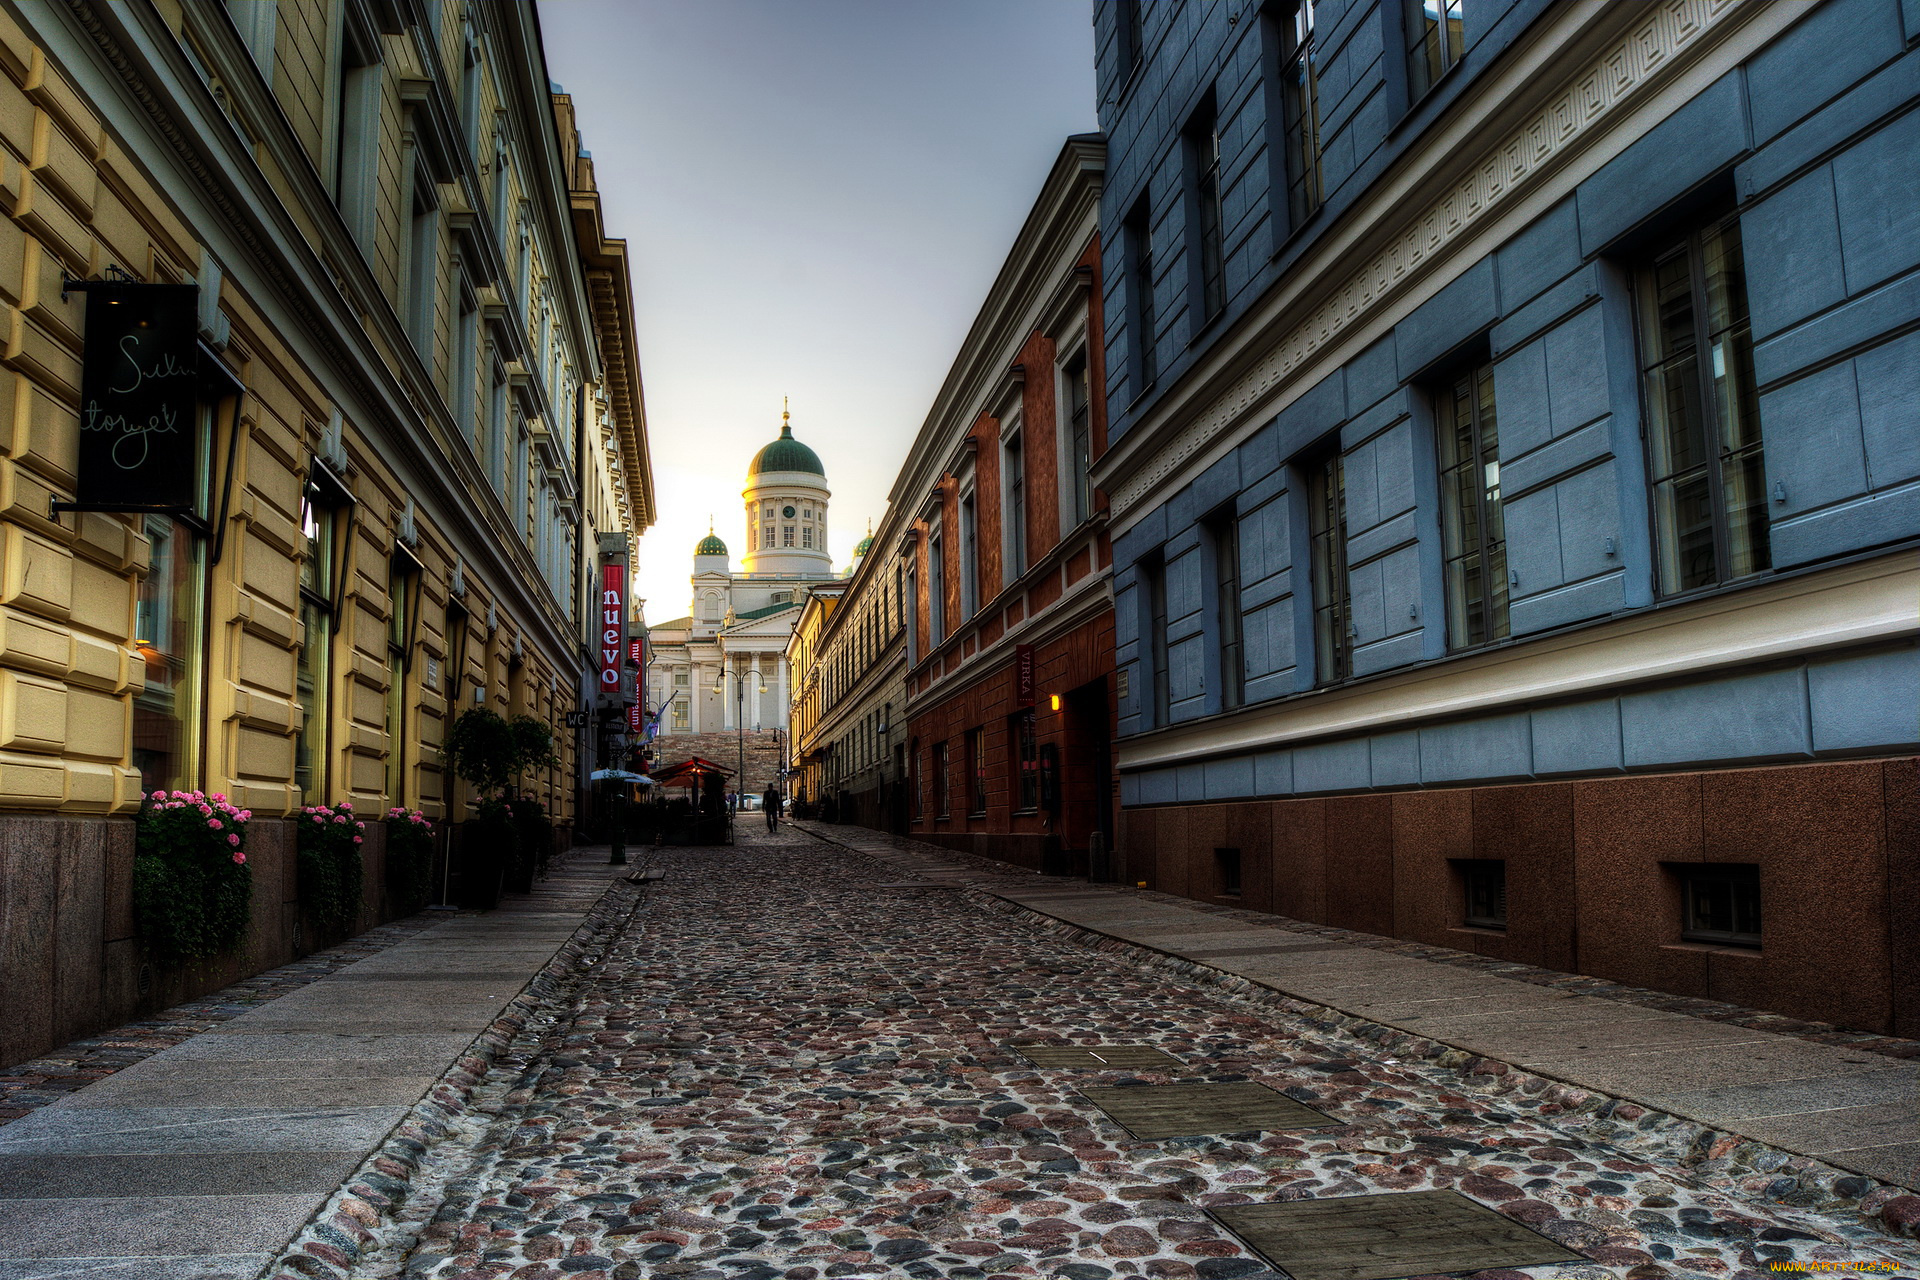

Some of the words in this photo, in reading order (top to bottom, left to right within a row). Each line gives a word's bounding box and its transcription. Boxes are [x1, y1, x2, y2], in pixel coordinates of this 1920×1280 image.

[602, 589, 621, 684] nuevo
[1022, 651, 1031, 694] VIRKA
[568, 713, 585, 726] WC
